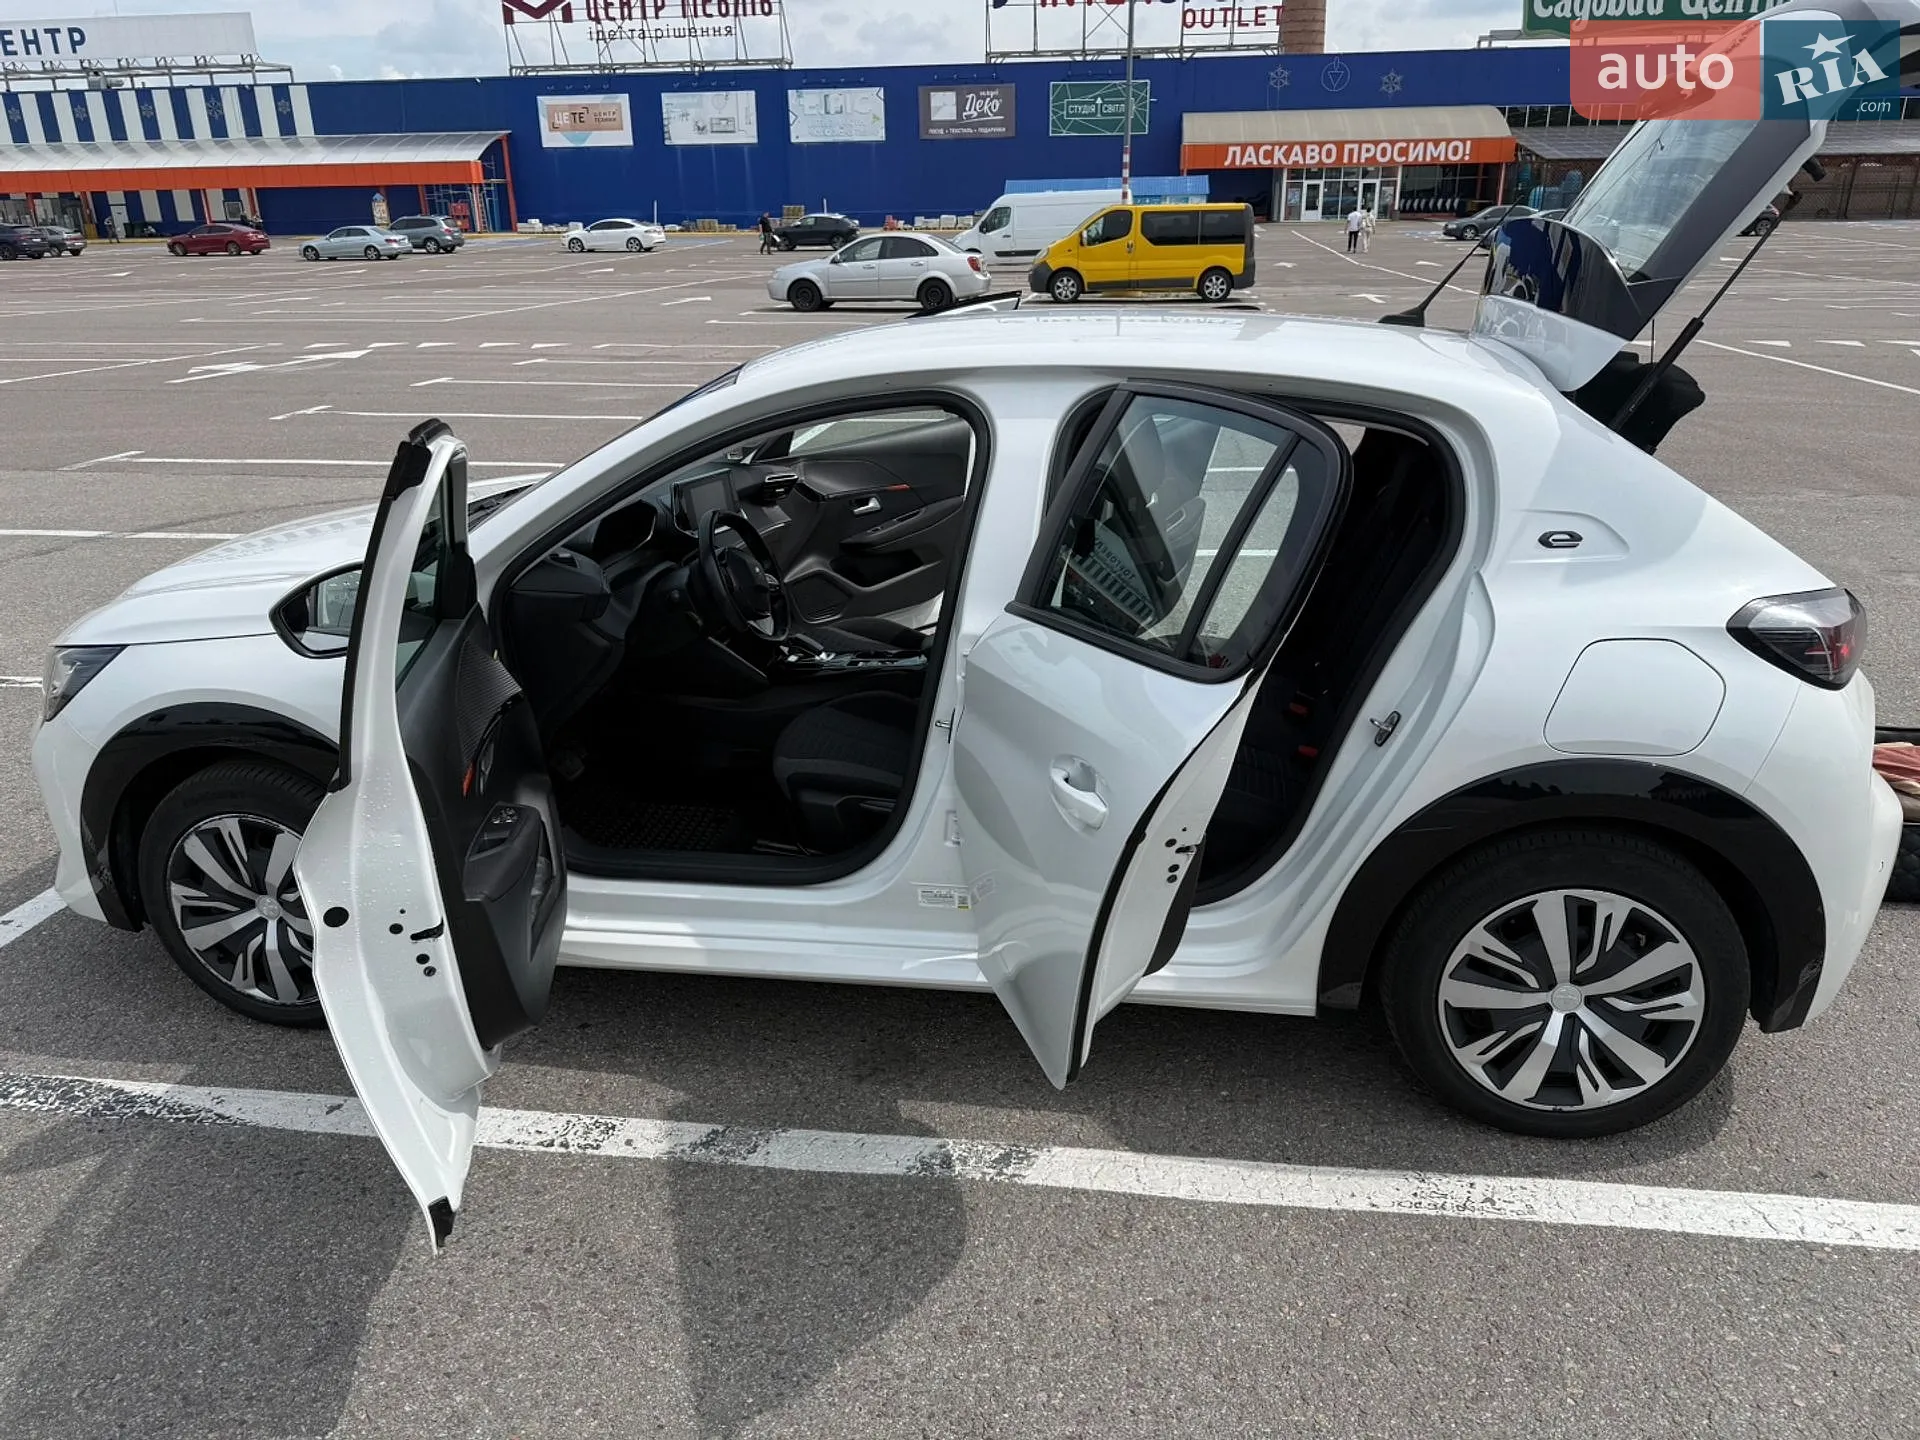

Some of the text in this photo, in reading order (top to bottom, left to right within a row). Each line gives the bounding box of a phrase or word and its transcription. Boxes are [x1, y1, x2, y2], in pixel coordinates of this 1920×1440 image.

[1183, 5, 1284, 29] OUTLET
[654, 24, 733, 43] рішення
[1224, 139, 1473, 167] ЛАСКАВО ПРОСИМО!
